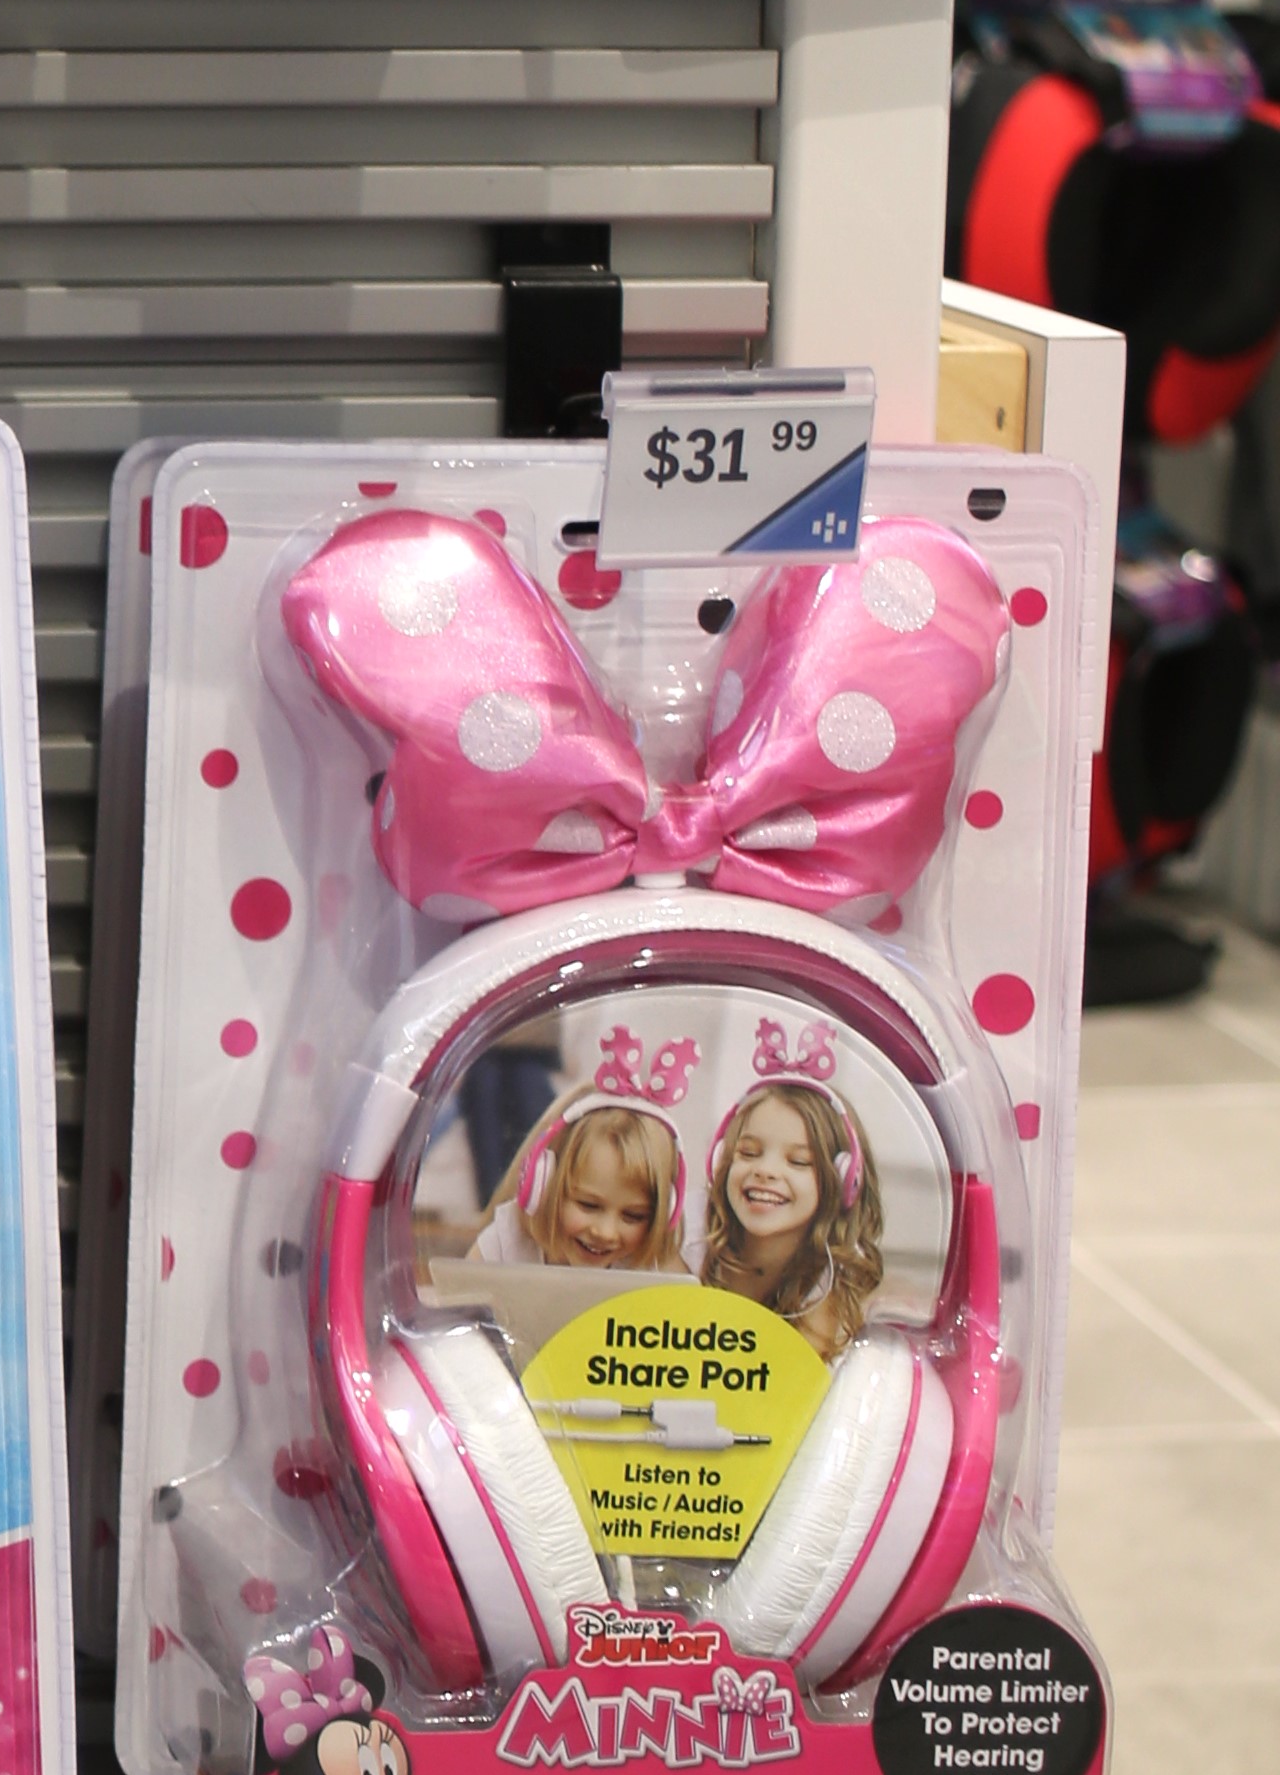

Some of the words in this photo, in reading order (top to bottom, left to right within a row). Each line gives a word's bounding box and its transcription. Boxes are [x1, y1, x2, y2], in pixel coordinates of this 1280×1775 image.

[643, 426, 748, 489] $31
[771, 420, 818, 452] 99
[605, 1318, 756, 1353] Includes
[587, 1355, 689, 1389] Share
[701, 1360, 769, 1391] Port
[932, 1646, 1051, 1672] Parental
[890, 1679, 994, 1705] Volume
[999, 1679, 1088, 1704] Limiter
[498, 1678, 800, 1767] MINNIE
